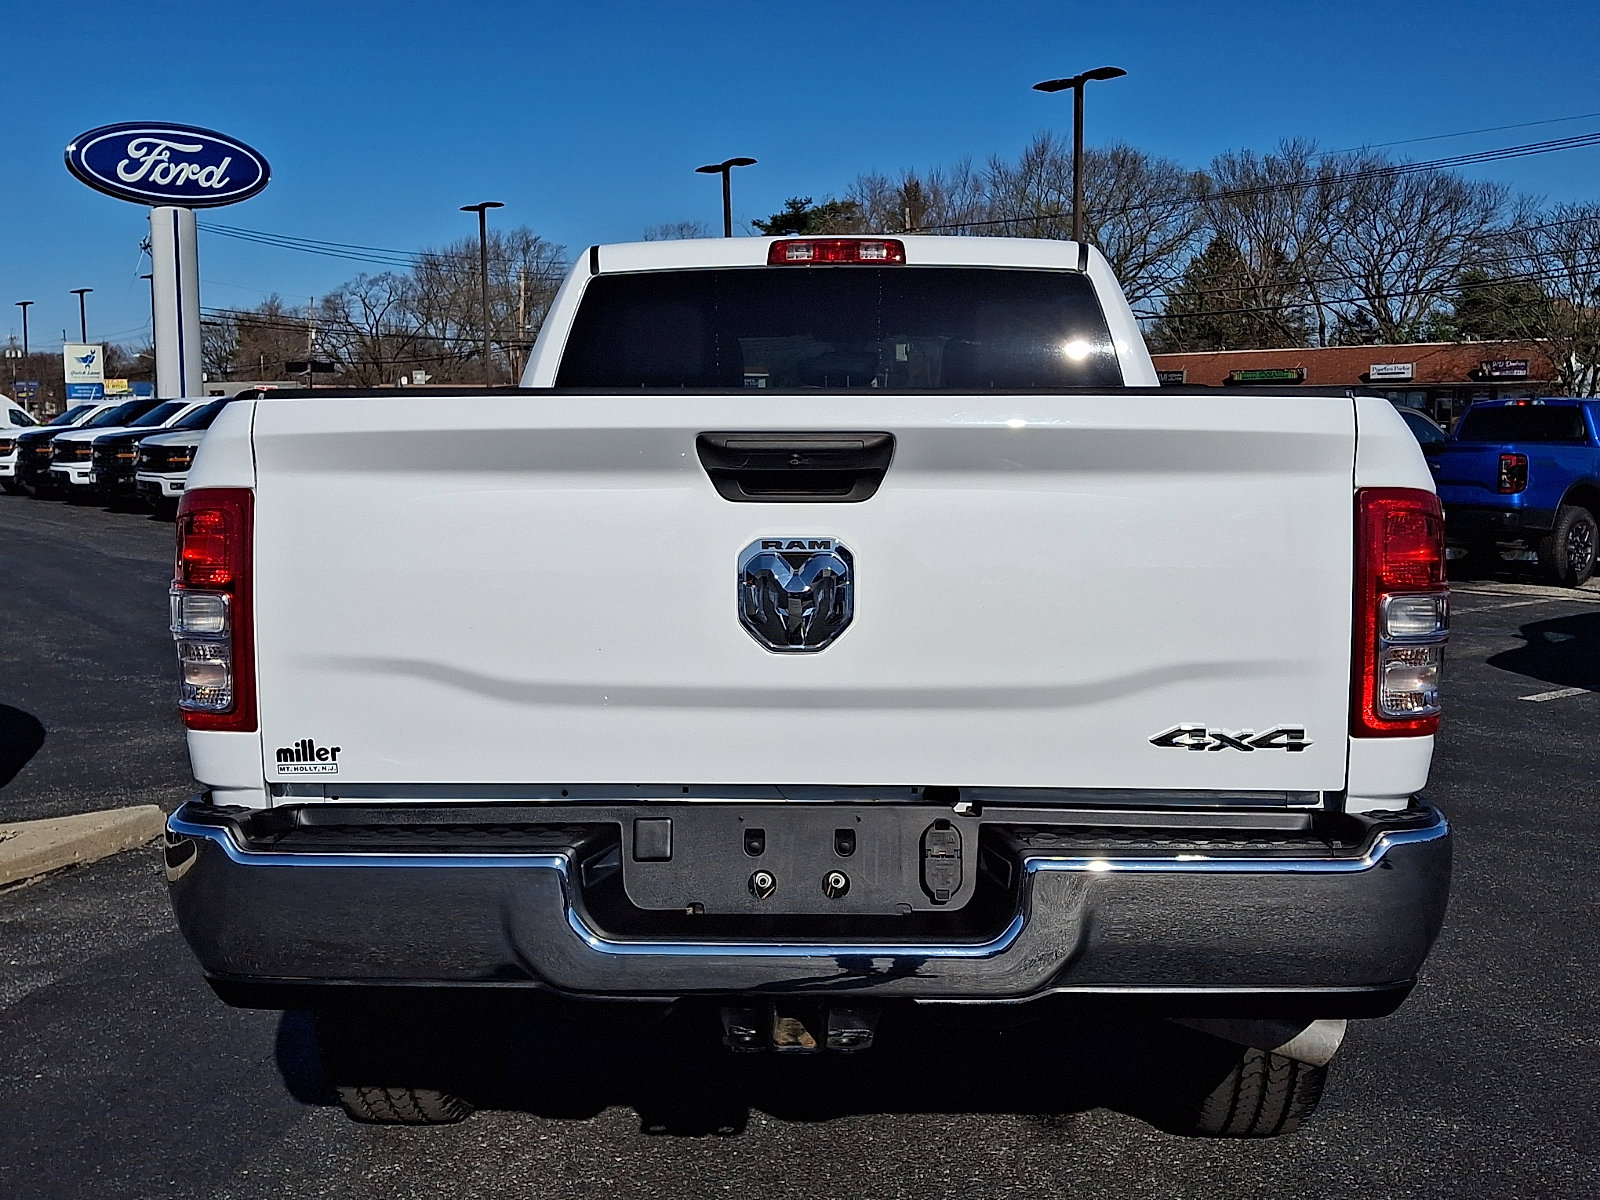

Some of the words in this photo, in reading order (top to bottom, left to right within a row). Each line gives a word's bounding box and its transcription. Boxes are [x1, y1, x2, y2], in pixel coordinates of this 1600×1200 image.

[117, 137, 232, 189] Ford
[761, 540, 831, 550] RAM
[276, 739, 341, 763] miller
